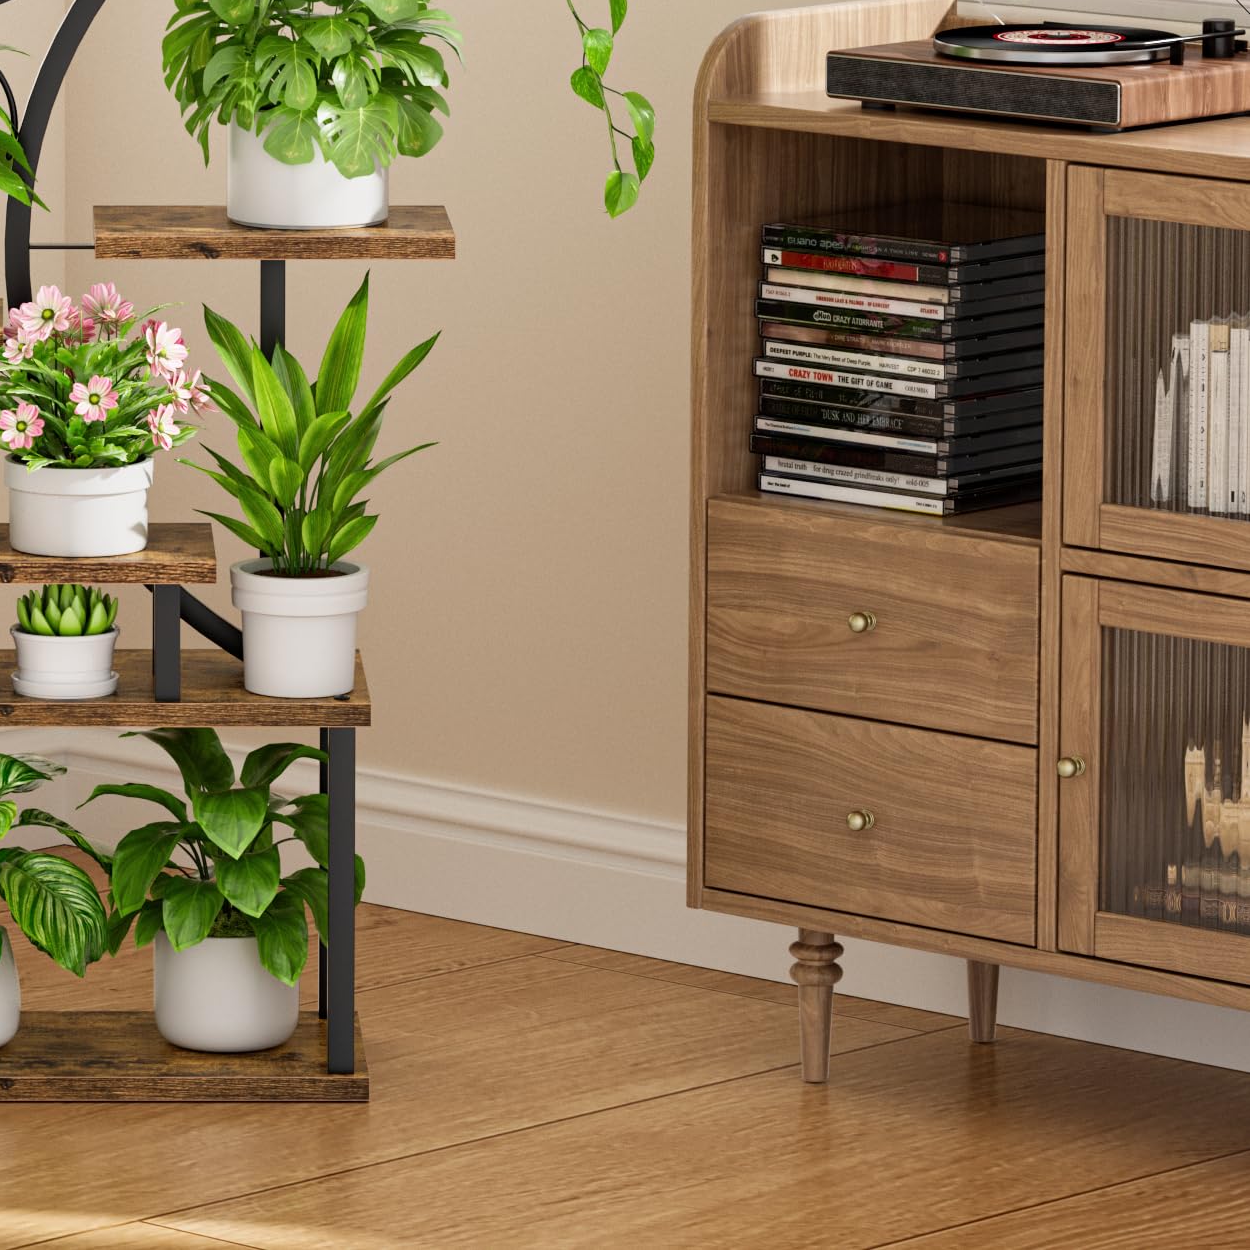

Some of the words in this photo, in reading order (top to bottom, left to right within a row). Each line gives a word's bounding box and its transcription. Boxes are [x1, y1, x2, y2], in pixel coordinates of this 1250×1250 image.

[832, 315, 850, 325] CRAZY
[851, 317, 884, 329] ATORRANTE
[769, 347, 791, 355] DEEPEST
[792, 350, 812, 358] PURPLE:
[788, 368, 811, 379] CRAZY
[813, 371, 833, 382] TOWN
[838, 375, 849, 384] THE
[851, 377, 864, 387] GIFT
[876, 381, 893, 390] GAME
[904, 385, 929, 395] COLUMBIA
[842, 410, 856, 423] AND
[778, 460, 793, 469] brutal
[794, 462, 808, 471] truth
[813, 464, 821, 472] for
[823, 466, 835, 476] drug
[835, 467, 853, 477] crazed
